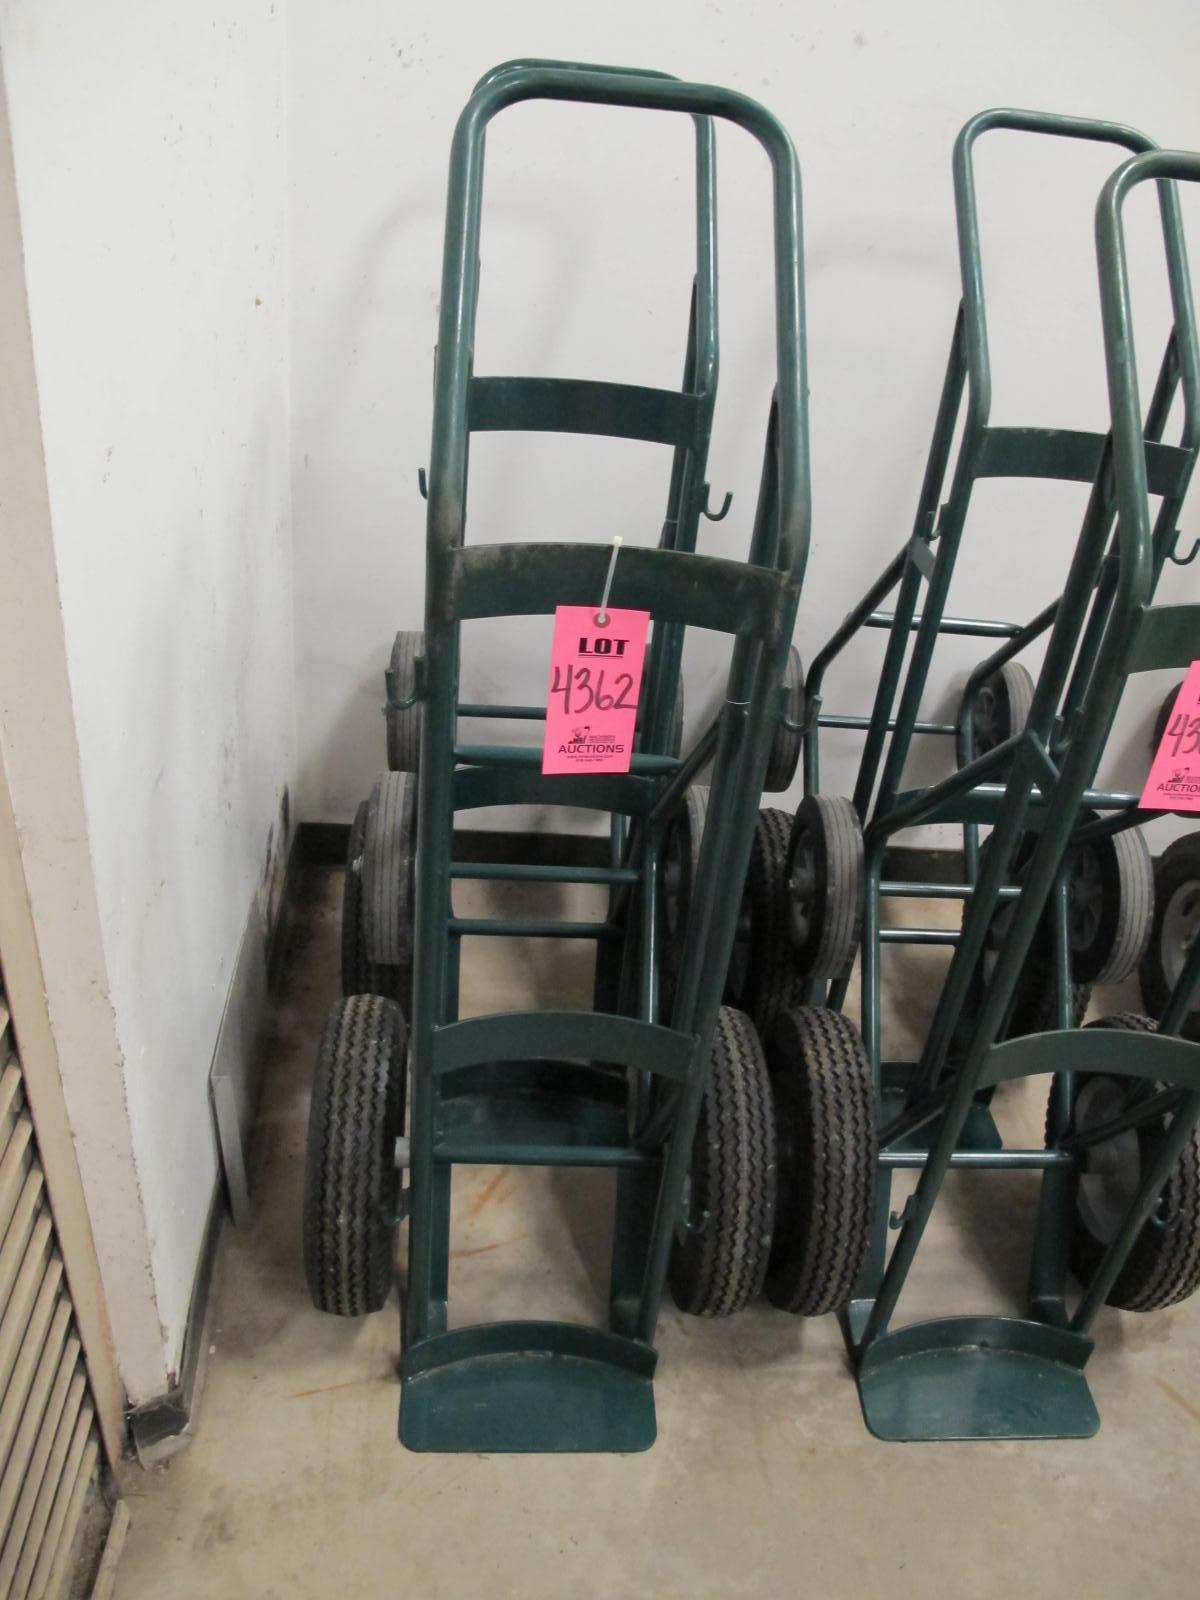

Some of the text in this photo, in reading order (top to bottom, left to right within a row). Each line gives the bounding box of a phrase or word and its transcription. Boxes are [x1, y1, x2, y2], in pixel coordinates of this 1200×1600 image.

[578, 637, 630, 656] LOT
[551, 664, 639, 715] 4362
[557, 744, 625, 754] AUCTIONS
[1156, 783, 1200, 793] AUCTIO
